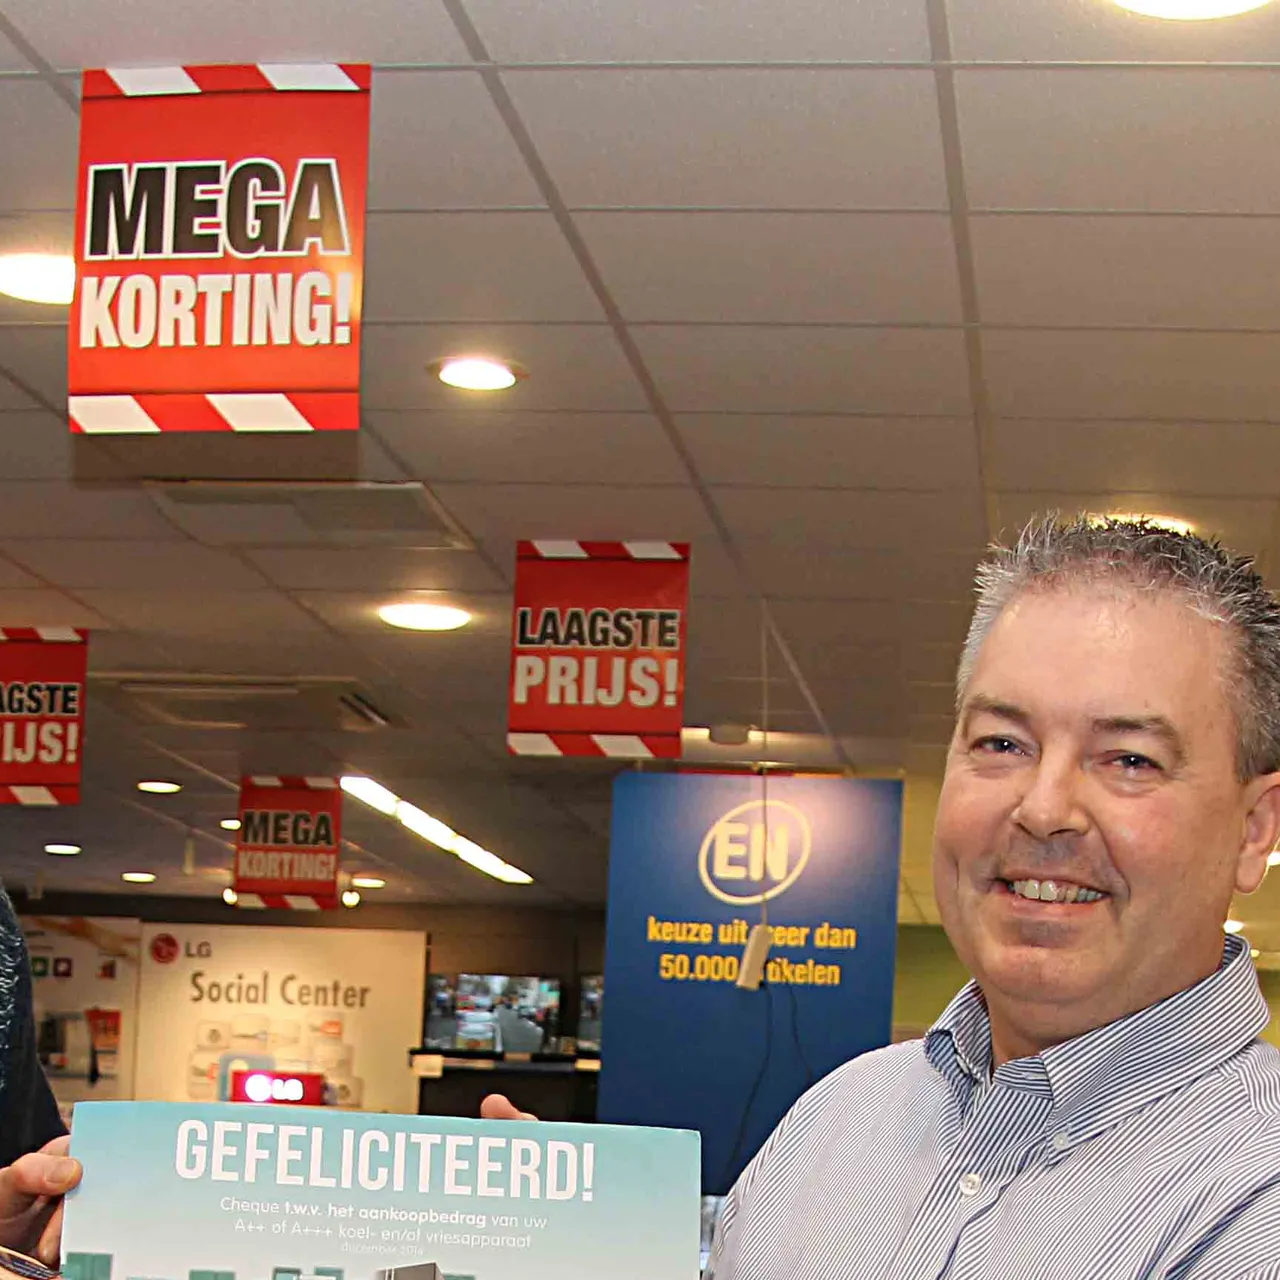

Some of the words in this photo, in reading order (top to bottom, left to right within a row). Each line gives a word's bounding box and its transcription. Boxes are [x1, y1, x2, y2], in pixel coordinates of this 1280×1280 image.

[84, 158, 351, 260] MEGA
[79, 271, 353, 348] KORTING!
[517, 606, 681, 651] LAAGSTE
[514, 655, 679, 707] PRIJS!
[242, 808, 334, 847] MEGA
[238, 850, 336, 881] KORTING!
[713, 822, 790, 882] EN
[184, 940, 212, 959] LG
[647, 916, 713, 944] keuze
[718, 918, 748, 945] uit
[767, 924, 811, 948] eer
[813, 921, 857, 950] dan
[659, 952, 739, 981] 50.000
[190, 970, 269, 1005] Social
[280, 974, 371, 1009] Center
[175, 1119, 595, 1202] GEFELICITEERD!
[220, 1196, 280, 1216] Cheque
[284, 1200, 322, 1216] t.w.v.
[327, 1202, 354, 1219] het
[358, 1206, 487, 1229] aankoopbedrag
[491, 1213, 519, 1228] van
[523, 1216, 548, 1230] uw
[272, 1219, 288, 1234] of
[338, 1225, 376, 1240] koel-
[426, 1230, 532, 1250] vriesapparaat
